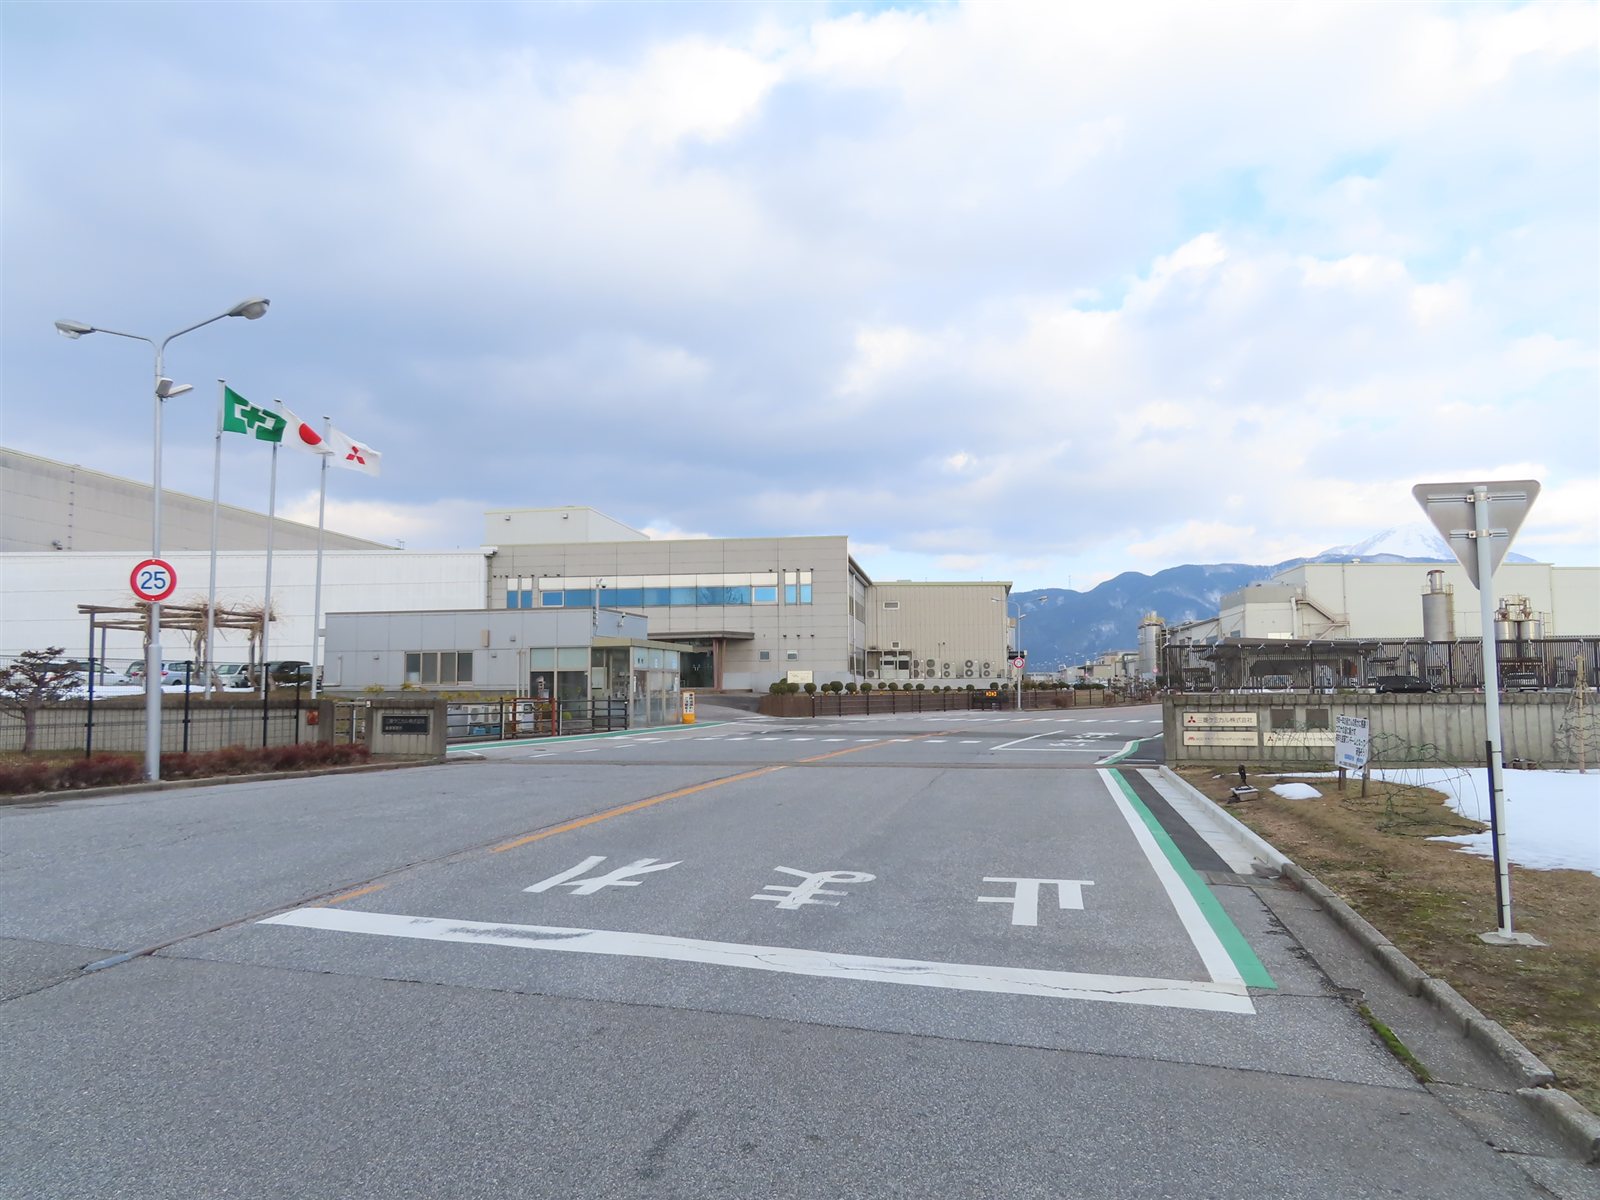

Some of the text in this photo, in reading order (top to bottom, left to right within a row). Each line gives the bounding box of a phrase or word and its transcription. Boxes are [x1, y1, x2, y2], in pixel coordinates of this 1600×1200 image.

[141, 571, 166, 590] 25
[523, 856, 1095, 926] 止まれ
